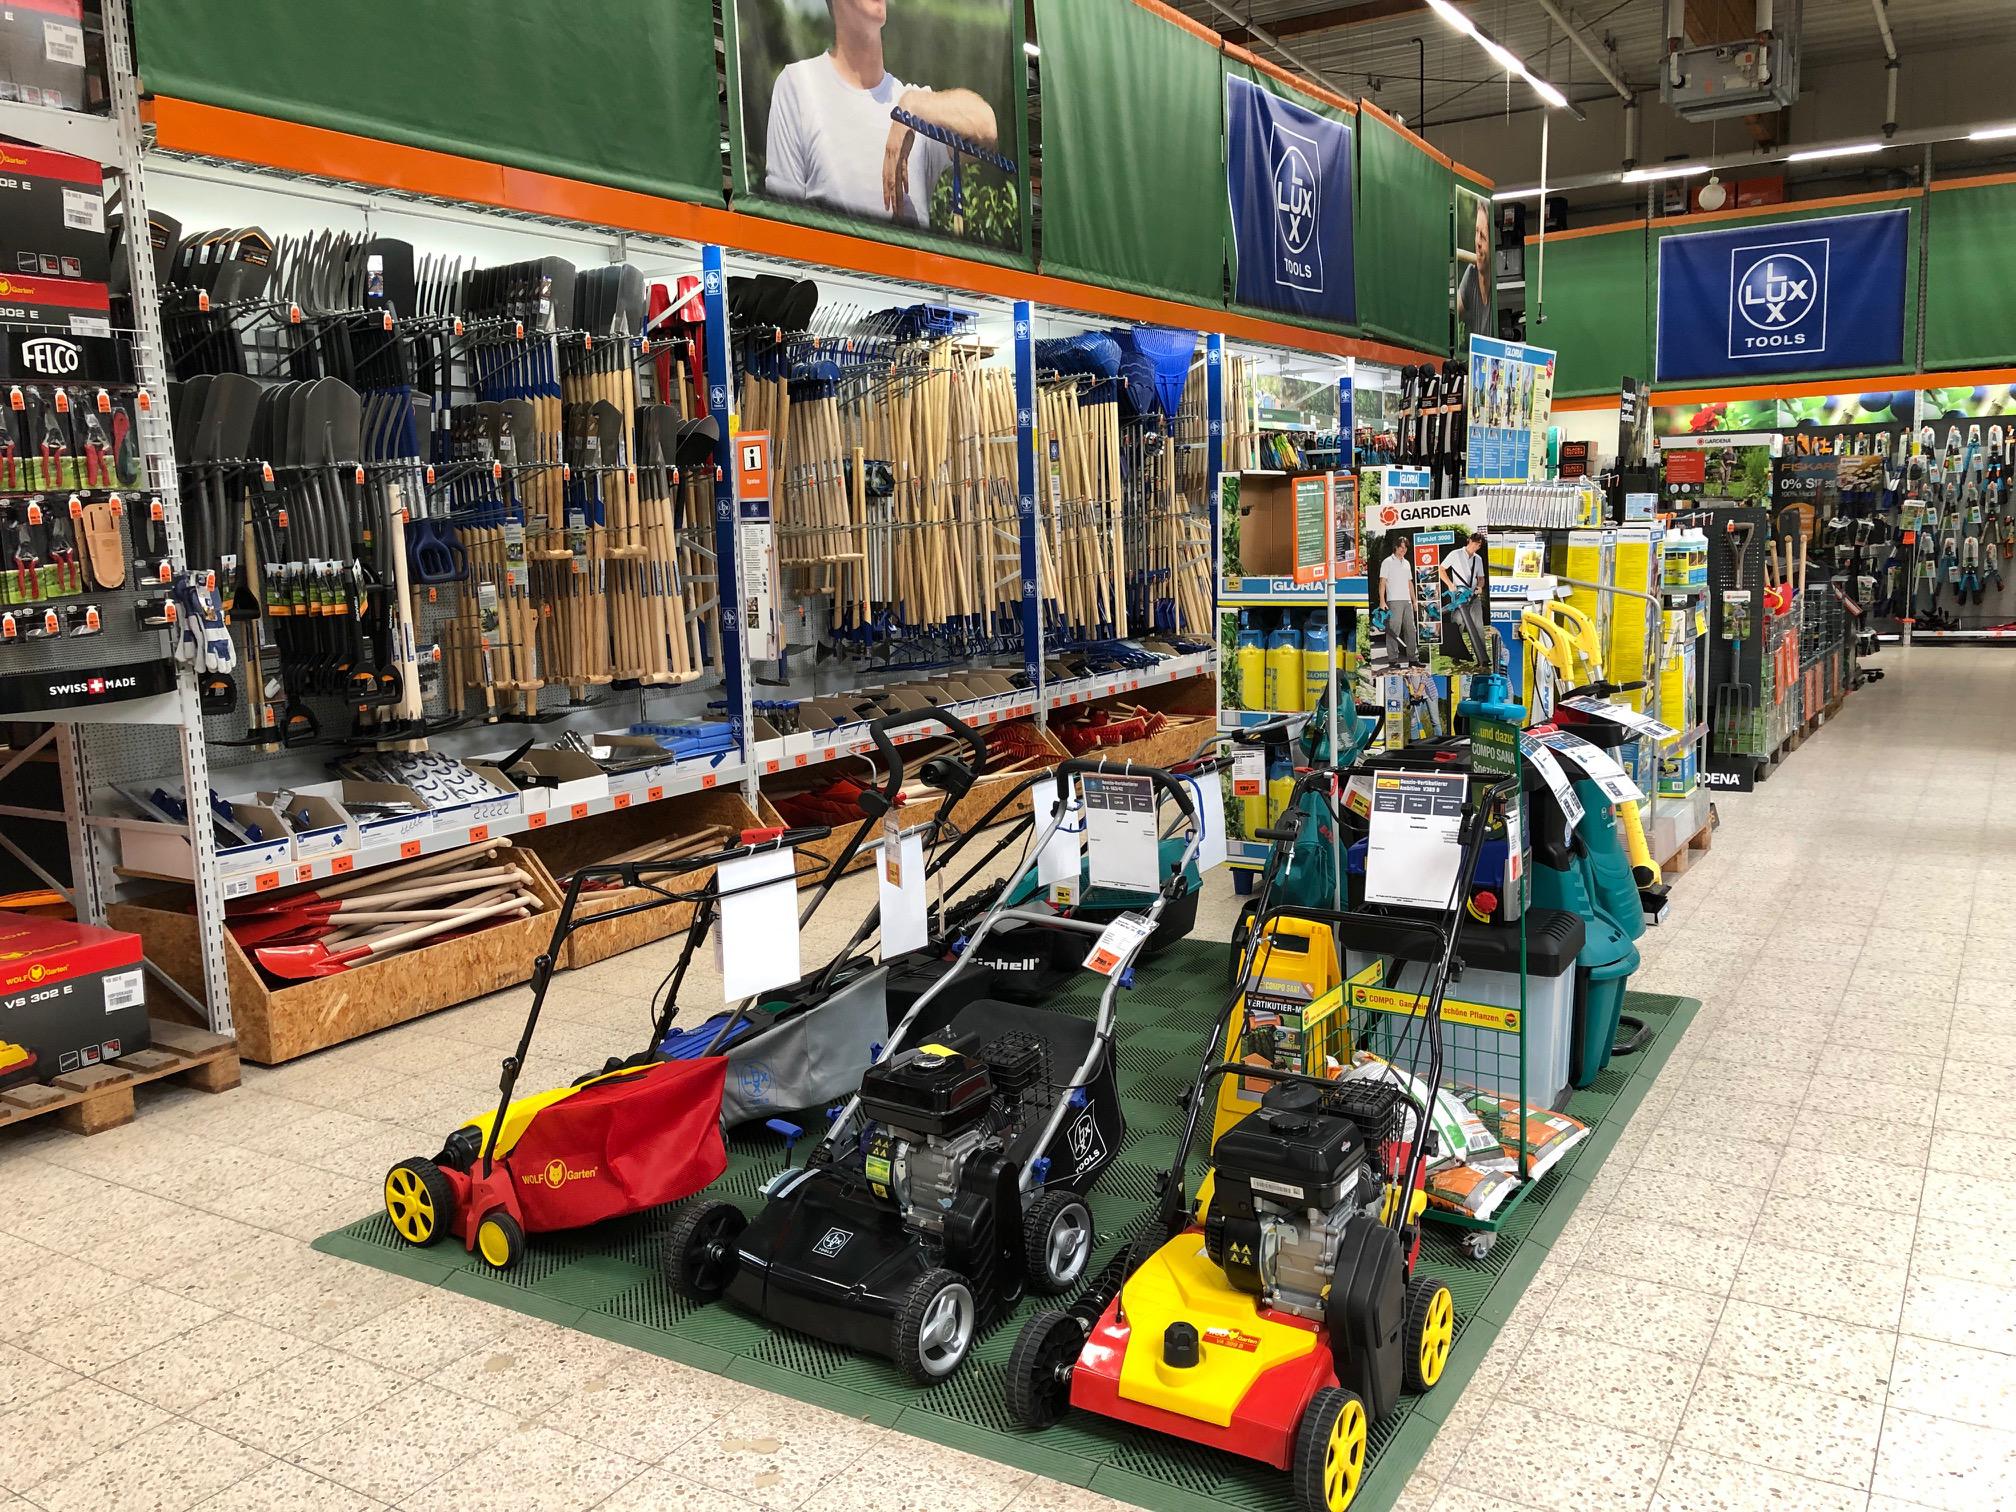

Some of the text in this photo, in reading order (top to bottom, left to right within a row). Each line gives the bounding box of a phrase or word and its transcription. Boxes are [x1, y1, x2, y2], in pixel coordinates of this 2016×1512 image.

[0, 177, 18, 189] 02
[1283, 257, 1312, 278] TOOLS
[11, 285, 35, 295] Garten
[30, 310, 39, 319] E
[1745, 333, 1806, 348] TOOLS
[22, 337, 79, 375] FELCO
[1781, 462, 1838, 472] FISKAR
[1401, 473, 1418, 484] GLORIA
[1781, 478, 1802, 489] 0%
[1401, 503, 1471, 521] GARDENA
[1272, 580, 1324, 592] GLORIA
[1489, 584, 1528, 593] BRUSH
[49, 677, 136, 696] SWISS MADE
[1471, 742, 1516, 766] COMPO SANA
[5, 975, 28, 986] WOLF
[4, 985, 74, 1009] VS 302 E
[1443, 1006, 1468, 1017] schöne
[1075, 1148, 1100, 1174] TOOLS
[521, 1166, 596, 1185] WOLF Garten
[1237, 1335, 1259, 1345] Garten
